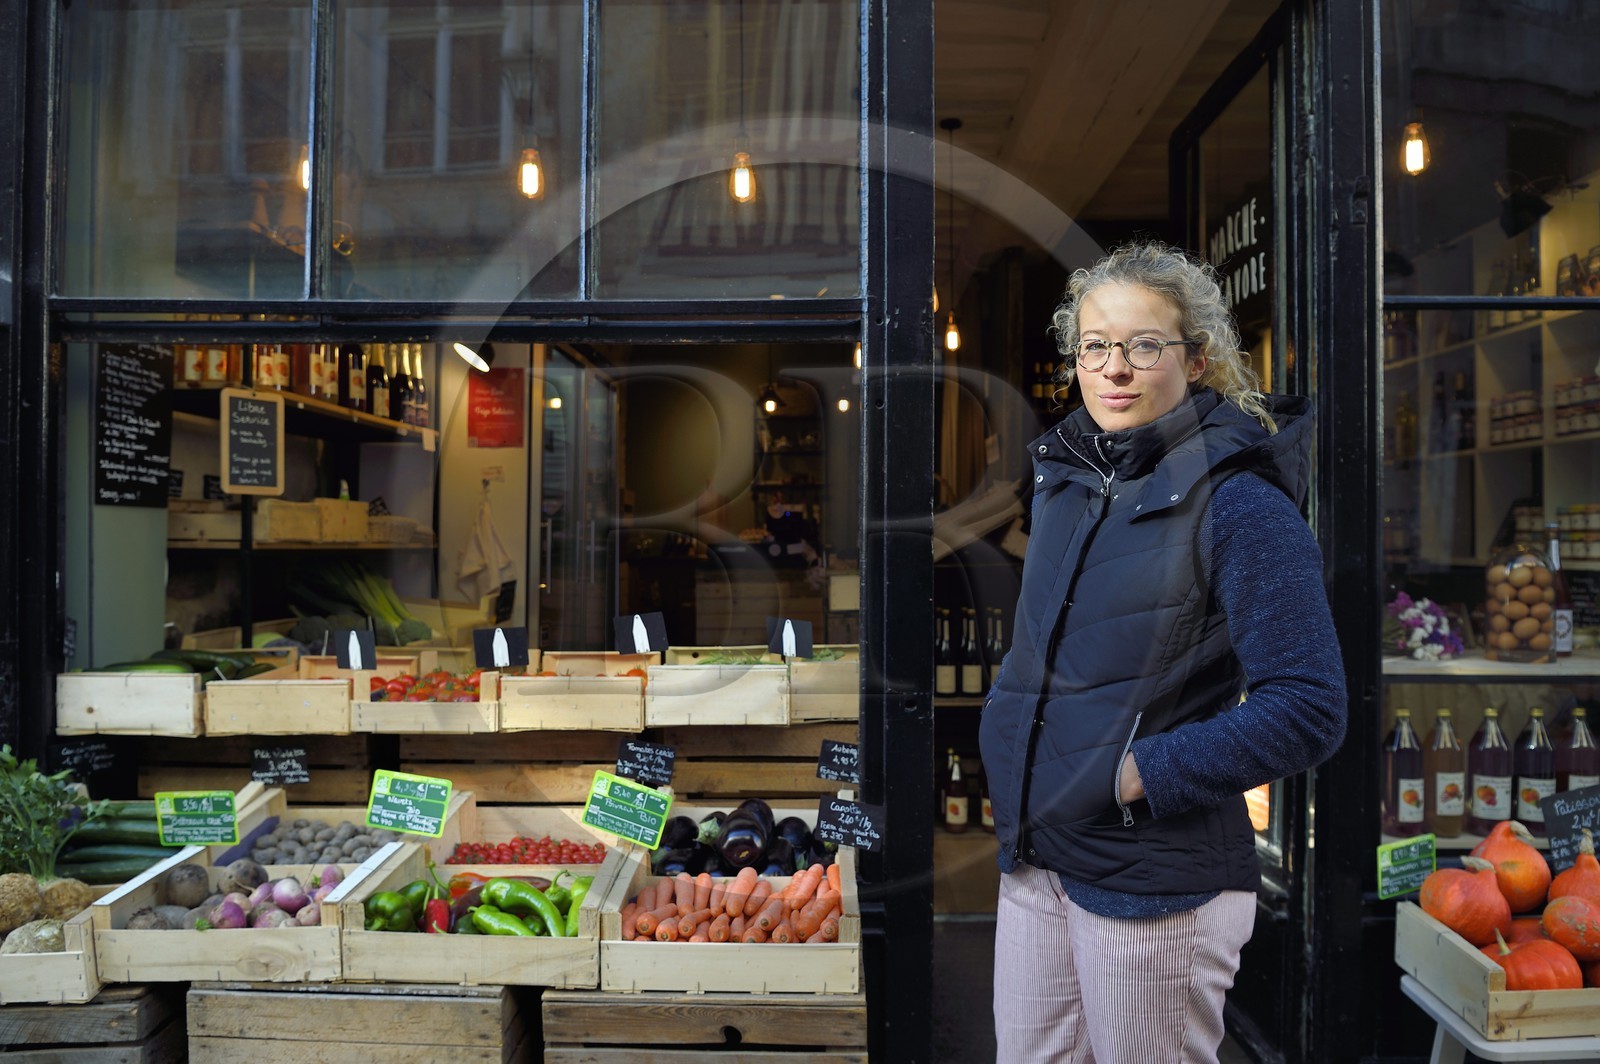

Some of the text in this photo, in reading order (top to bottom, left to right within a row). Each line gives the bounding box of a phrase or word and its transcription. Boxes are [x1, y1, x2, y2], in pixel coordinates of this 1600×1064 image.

[238, 400, 266, 414] Libre
[232, 411, 271, 426] Service
[627, 742, 654, 754] Tomates
